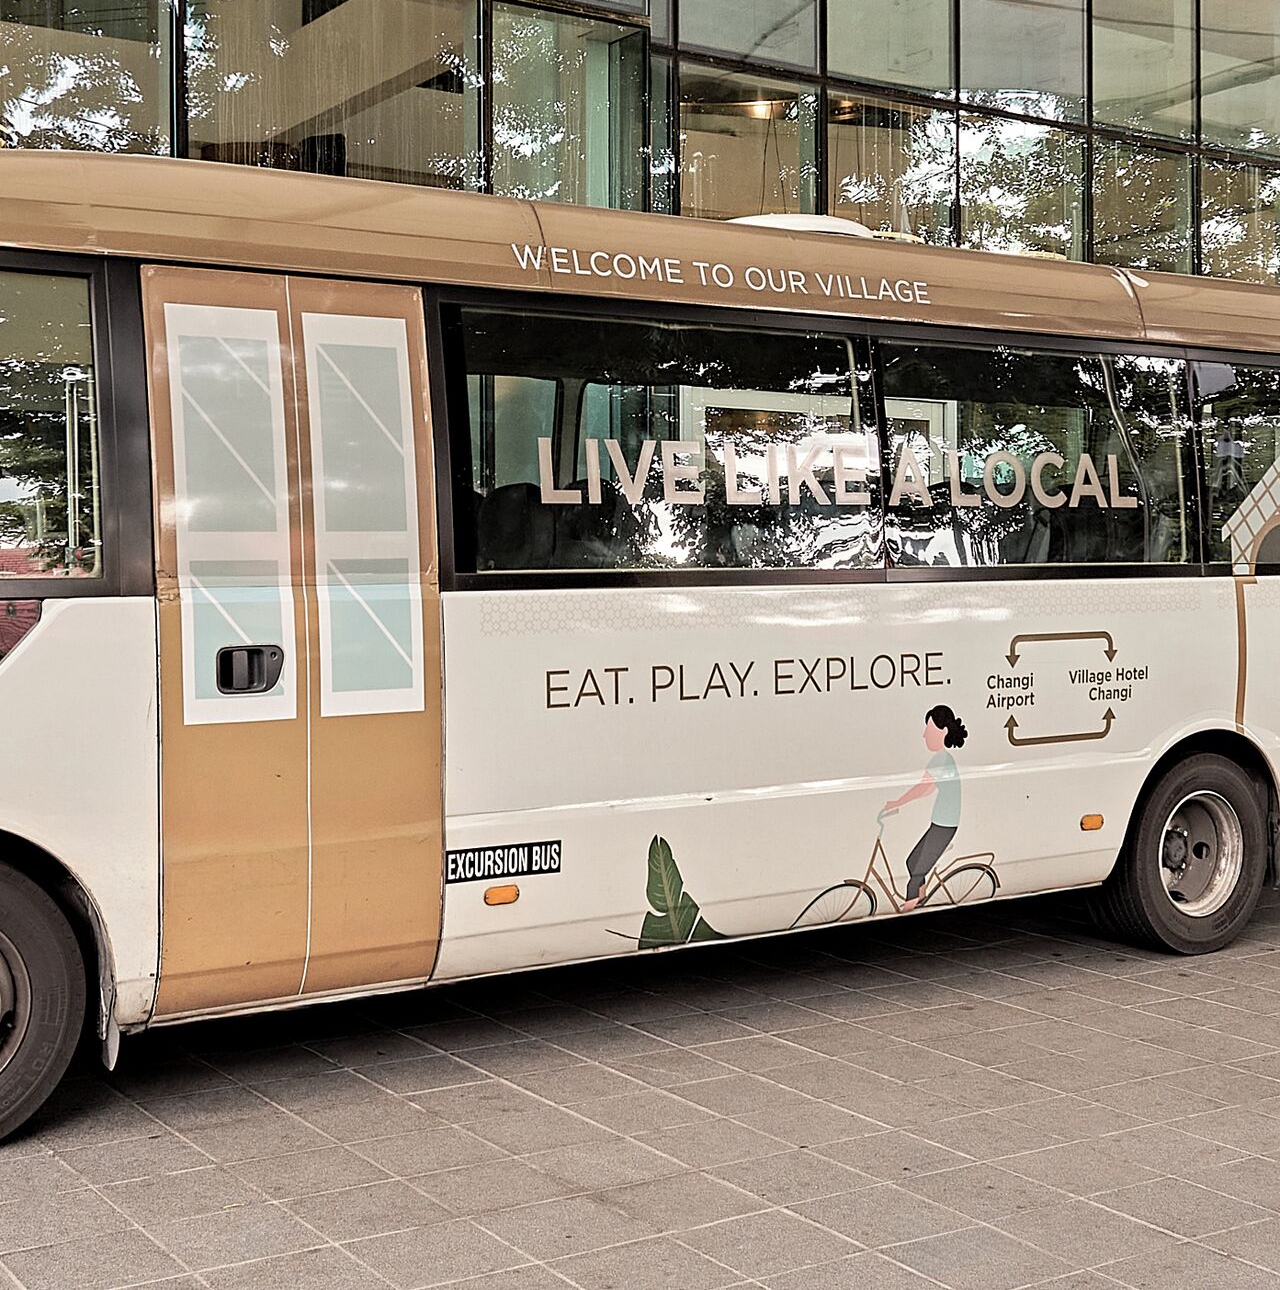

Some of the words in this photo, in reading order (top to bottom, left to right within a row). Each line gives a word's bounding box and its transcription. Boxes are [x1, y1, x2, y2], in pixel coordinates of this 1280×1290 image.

[511, 243, 683, 285] WELCOME
[693, 261, 734, 288] TO
[744, 267, 808, 295] OUR
[815, 272, 931, 305] VILLAGE
[538, 437, 705, 505] LIVE
[723, 441, 872, 506] LIKE
[888, 447, 934, 507] A
[947, 450, 1138, 509] LOCAL
[546, 667, 634, 709] EAT.
[651, 661, 759, 703] PLAY.
[774, 652, 952, 695] EXPLORE.
[986, 672, 1034, 690] Changi
[1069, 669, 1112, 685] Village
[1116, 666, 1148, 681] Hotel
[986, 692, 1035, 710] Airport
[1089, 685, 1132, 701] Changi
[447, 846, 528, 880] EXCURSION
[531, 843, 560, 871] BUS
